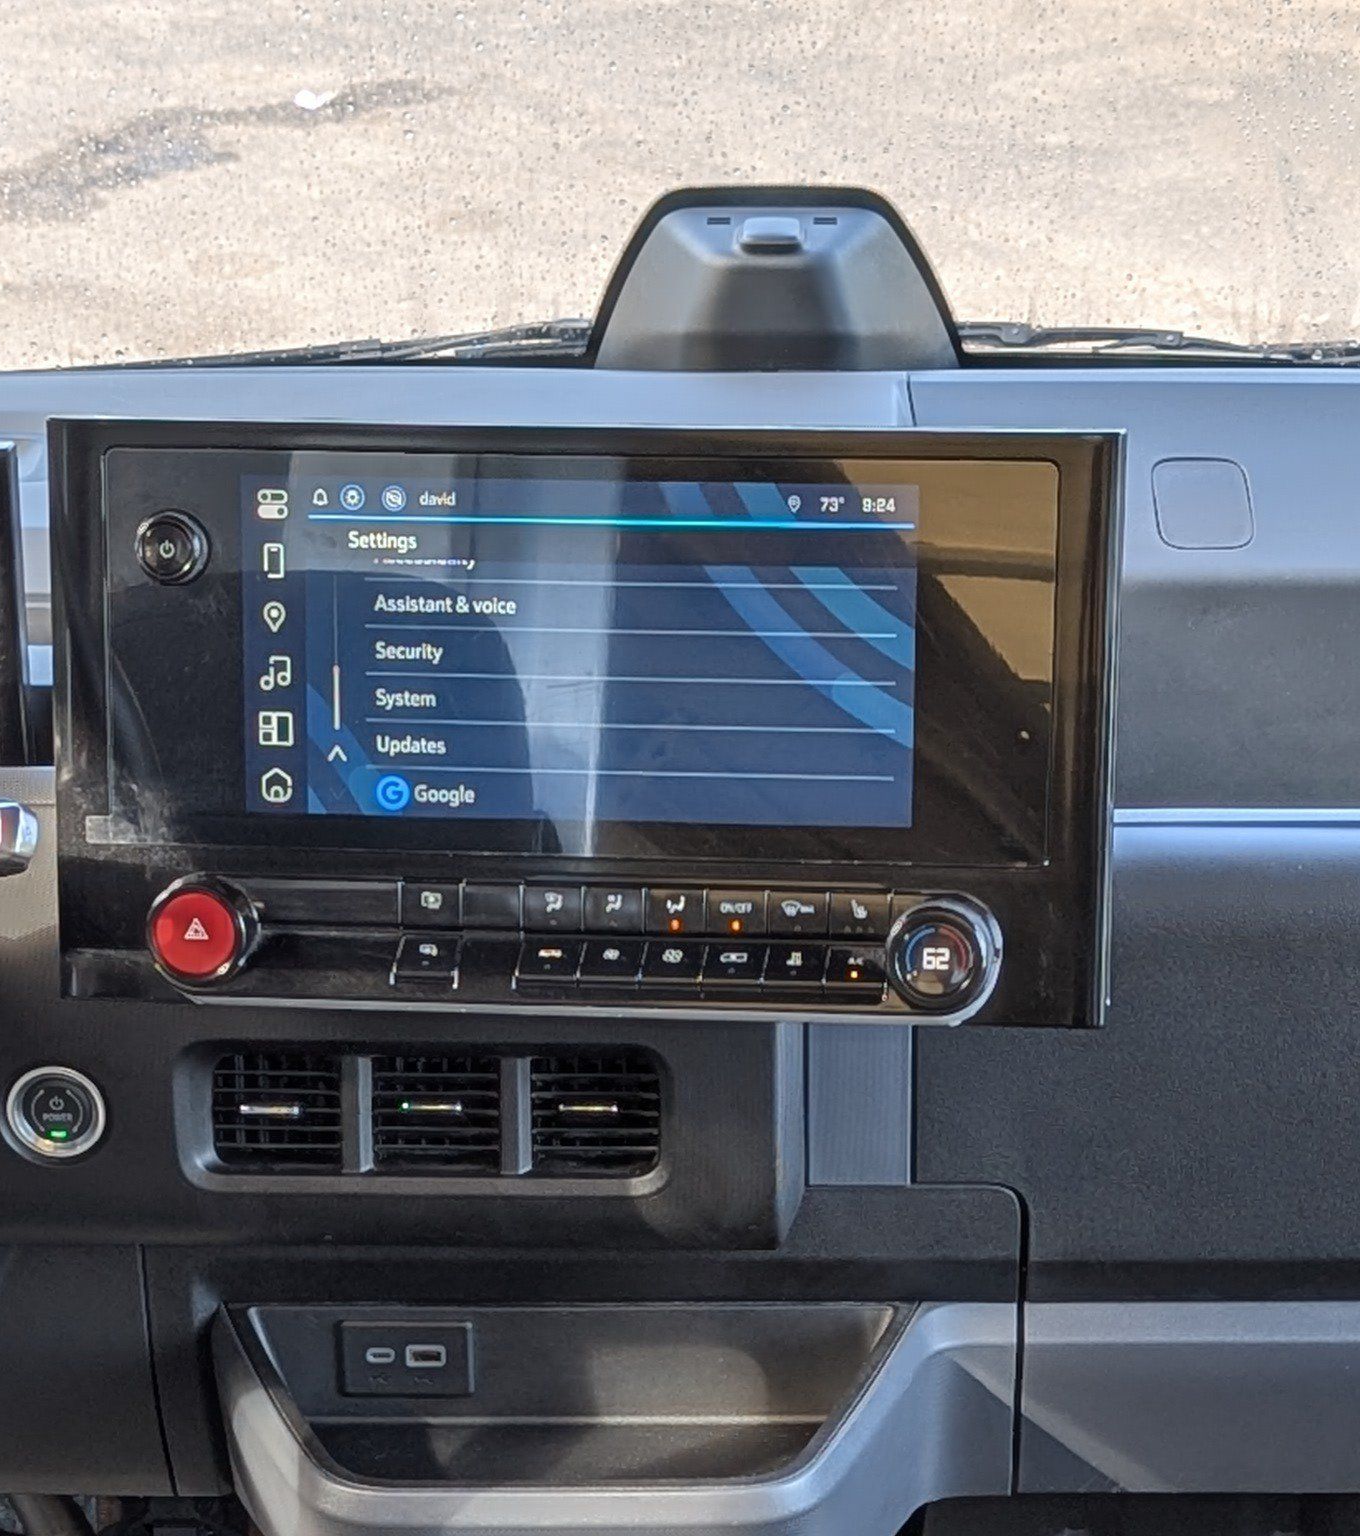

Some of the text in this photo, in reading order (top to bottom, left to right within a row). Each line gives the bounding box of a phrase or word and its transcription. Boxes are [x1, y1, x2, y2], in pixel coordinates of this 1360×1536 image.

[418, 491, 456, 507] david
[820, 496, 896, 513] 73° 9:24
[347, 530, 418, 553] Settings
[374, 594, 517, 615] Assistant & voice
[375, 641, 444, 665] Security
[375, 688, 437, 710] System
[376, 735, 447, 757] Updates
[413, 784, 476, 808] Google
[921, 947, 951, 971] 62
[42, 1112, 74, 1122] POWER
